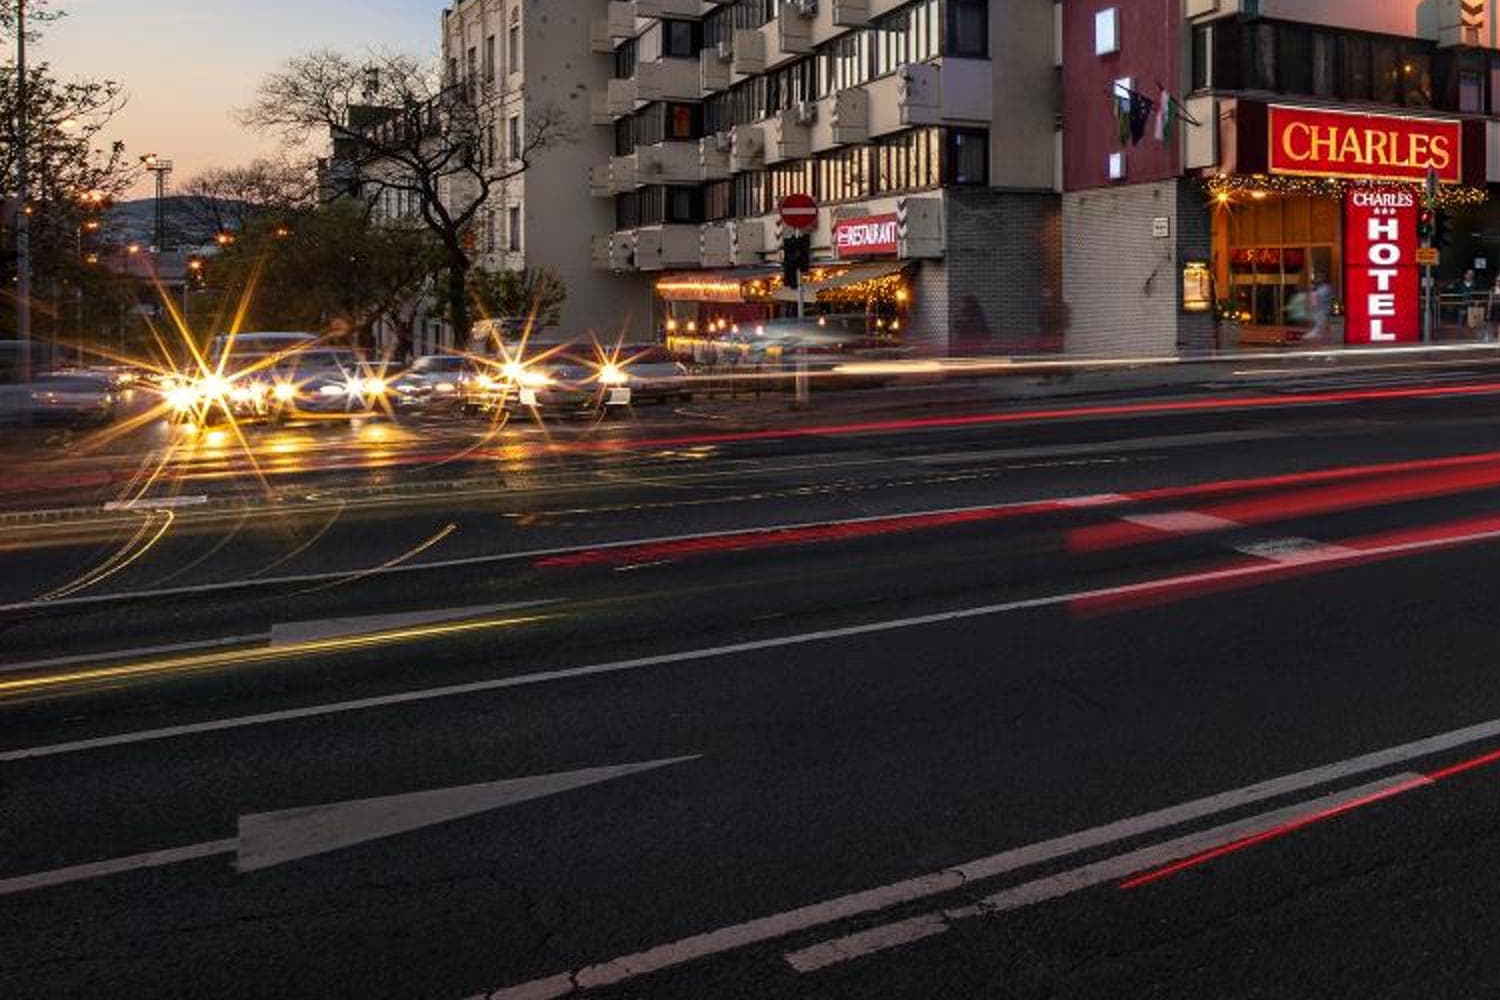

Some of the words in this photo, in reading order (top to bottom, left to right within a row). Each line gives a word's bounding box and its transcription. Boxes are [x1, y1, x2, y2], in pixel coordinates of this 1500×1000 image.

[1282, 121, 1450, 169] CHARLES
[1353, 192, 1413, 207] CHARLES
[1368, 218, 1400, 341] HOTEL
